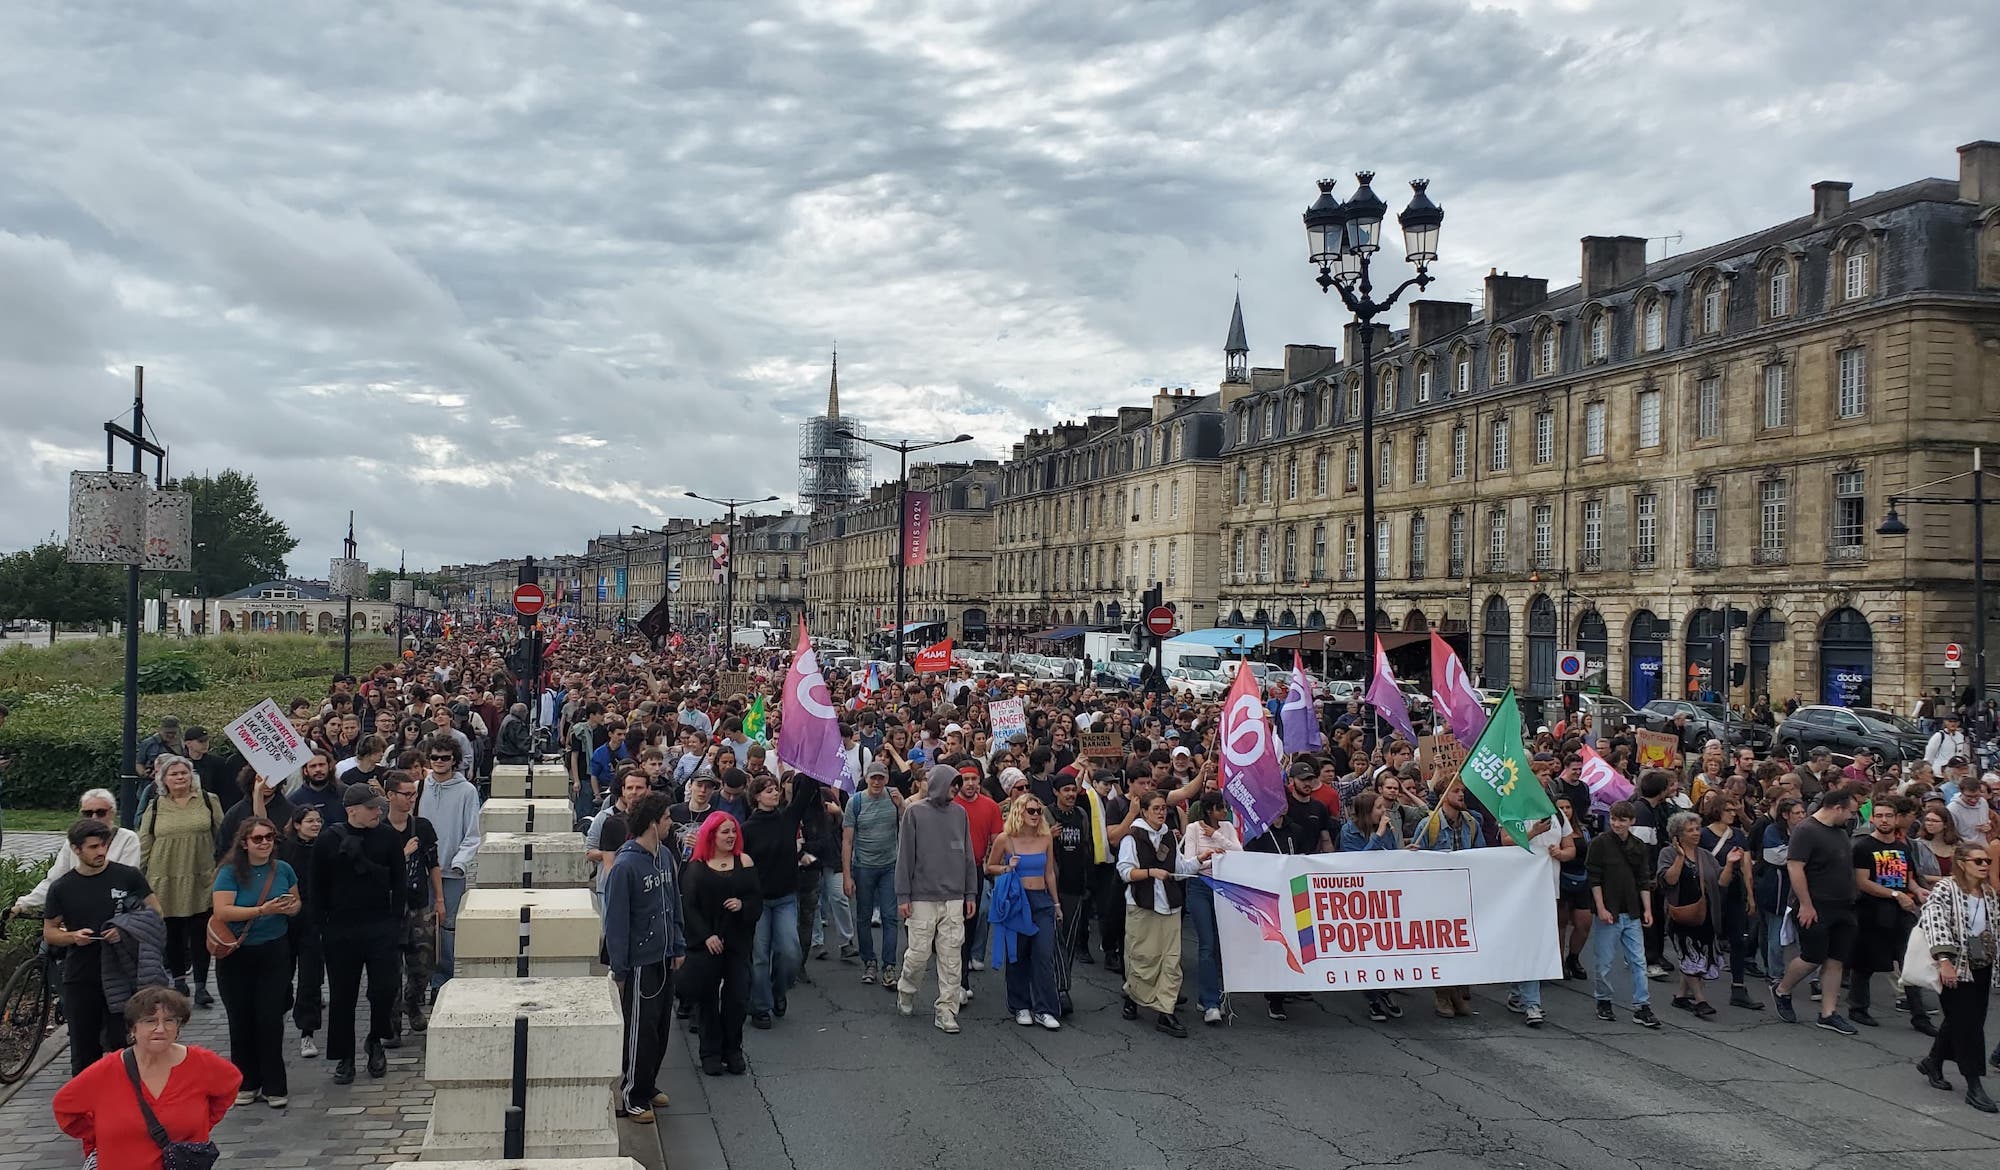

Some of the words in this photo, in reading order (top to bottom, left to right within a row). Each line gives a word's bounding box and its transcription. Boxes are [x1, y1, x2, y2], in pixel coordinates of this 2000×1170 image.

[913, 500, 922, 527] 2024
[911, 529, 920, 558] PARIS
[1586, 660, 1604, 668] docks
[1640, 662, 1659, 671] docks
[1699, 667, 1712, 675] doc
[1836, 672, 1863, 683] docks
[990, 699, 1022, 710] MACRON
[992, 713, 1025, 727] DANGER
[1231, 776, 1257, 807] FRANCE
[1313, 876, 1364, 889] NOUVEAU
[1314, 889, 1402, 921] FRONT
[1318, 918, 1470, 953] POPULAIRE
[1326, 966, 1441, 984] GIRONDE
